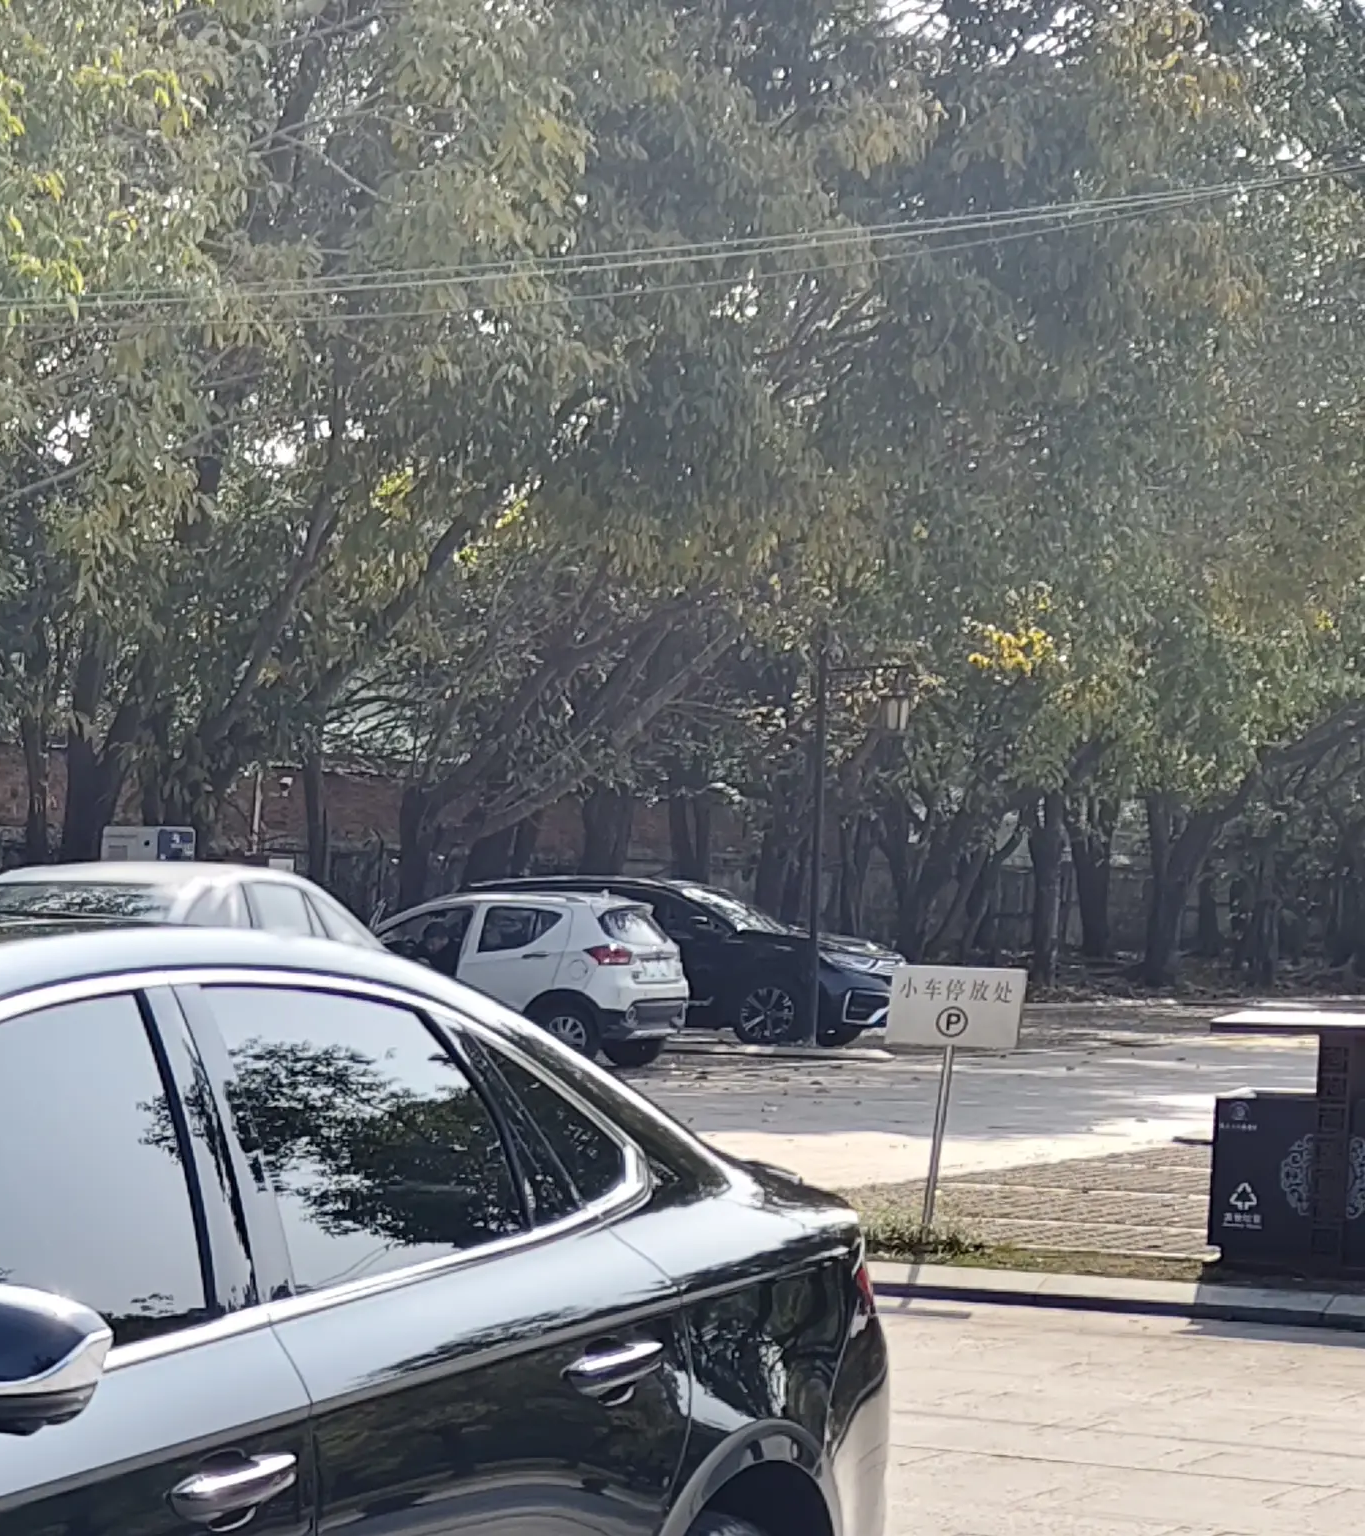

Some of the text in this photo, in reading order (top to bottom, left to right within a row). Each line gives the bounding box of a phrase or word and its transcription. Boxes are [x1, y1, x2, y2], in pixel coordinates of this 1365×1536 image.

[899, 976, 1013, 1004] 小车停放处
[946, 1013, 961, 1031] P
